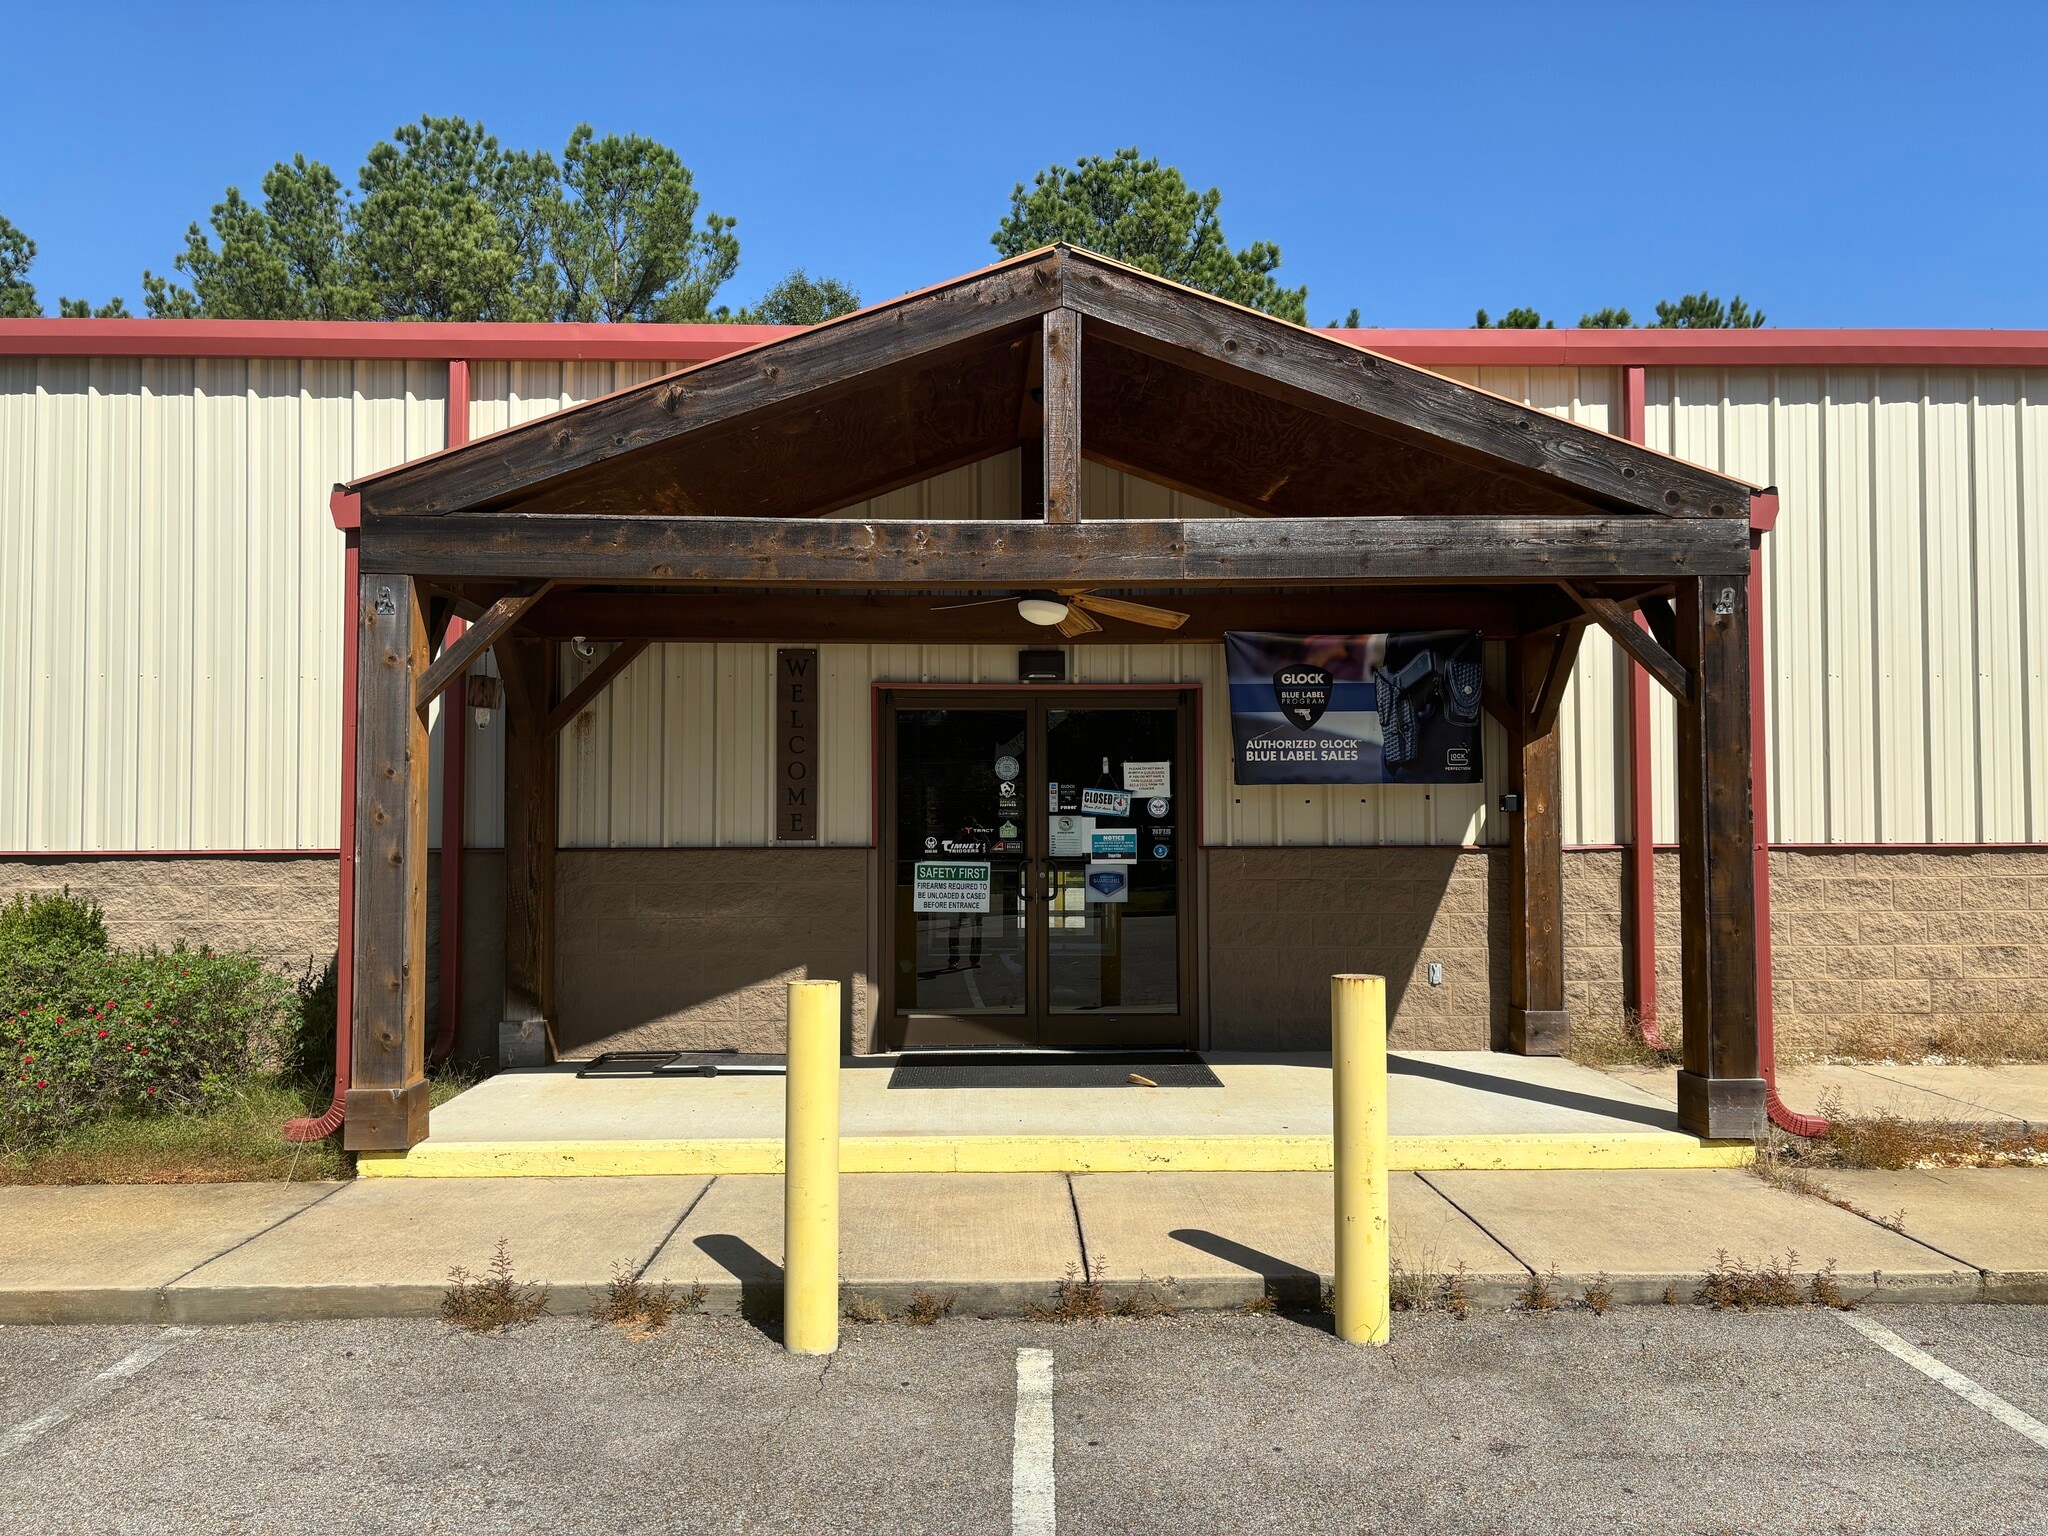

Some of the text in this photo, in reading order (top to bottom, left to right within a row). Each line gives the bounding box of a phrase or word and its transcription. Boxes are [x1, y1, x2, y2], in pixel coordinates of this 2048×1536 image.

[1281, 673, 1325, 685] GLOCK
[785, 658, 809, 831] WELCOME
[1245, 739, 1317, 750] AUTHORIZED
[1245, 750, 1359, 762] BLUE LABEL SALES
[1084, 791, 1114, 805] CLOSED
[920, 867, 986, 880] SAFETY FIRST
[948, 883, 978, 891] REQUIRED
[918, 891, 987, 900] BE UNLOADED & CASED
[924, 901, 980, 909] BEFORE ENTRANCE
